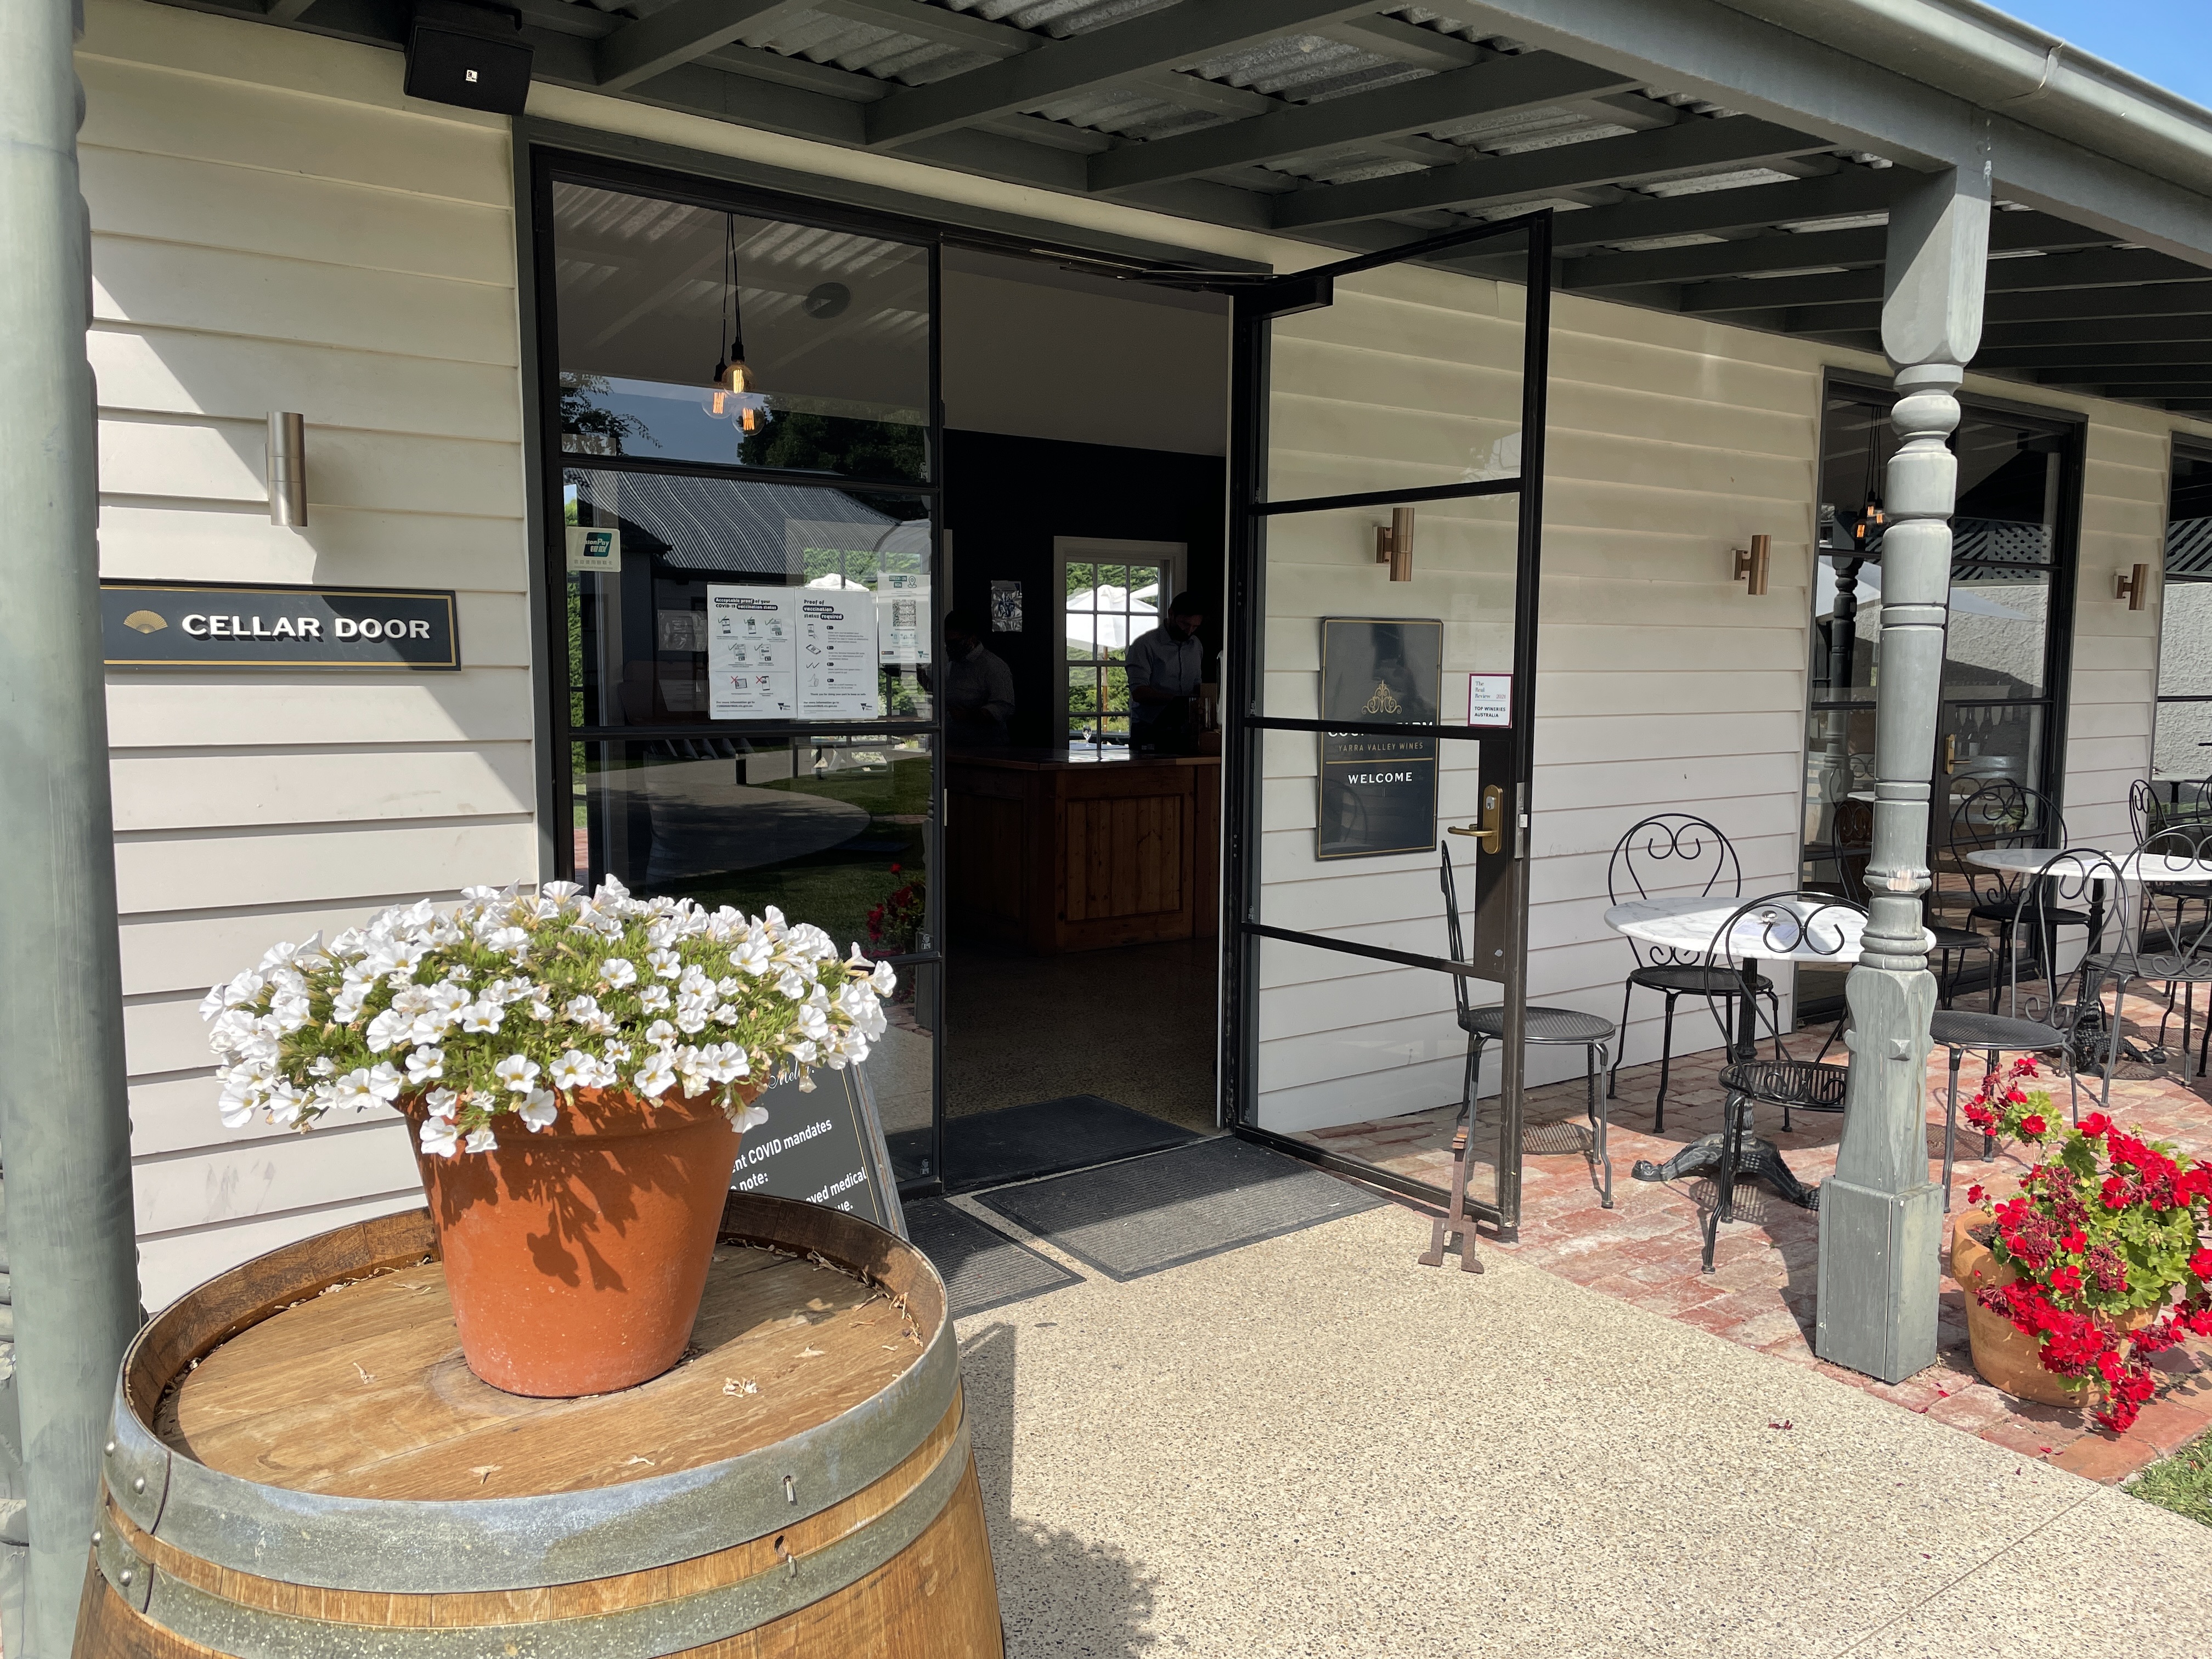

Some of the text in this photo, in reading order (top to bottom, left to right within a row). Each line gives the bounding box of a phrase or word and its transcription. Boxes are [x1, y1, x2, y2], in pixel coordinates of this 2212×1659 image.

[584, 538, 610, 548] ionPay
[182, 614, 430, 639] CELLAR DOOR
[1368, 743, 1396, 751] VALLEY
[1348, 772, 1413, 784] WELCOME
[732, 1119, 832, 1173] nt COVID mandates
[739, 1172, 768, 1190] note:
[830, 1166, 867, 1196] medical
